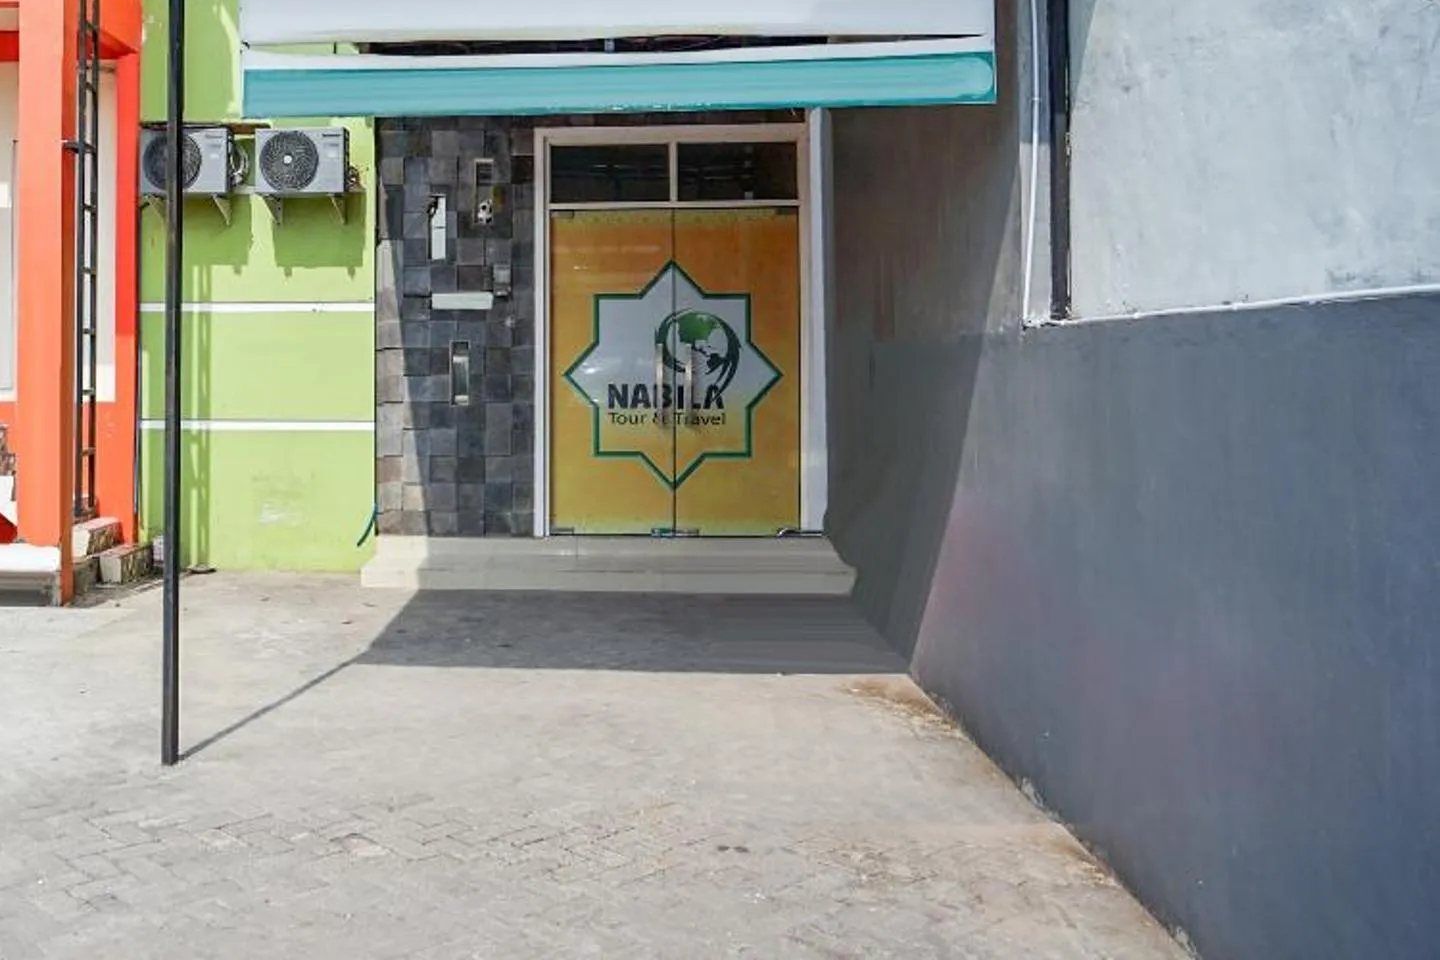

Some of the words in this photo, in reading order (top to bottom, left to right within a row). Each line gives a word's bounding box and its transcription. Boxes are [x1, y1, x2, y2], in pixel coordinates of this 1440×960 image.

[608, 383, 724, 409] NABILA
[608, 412, 647, 426] Tour
[674, 412, 726, 426] Travel
